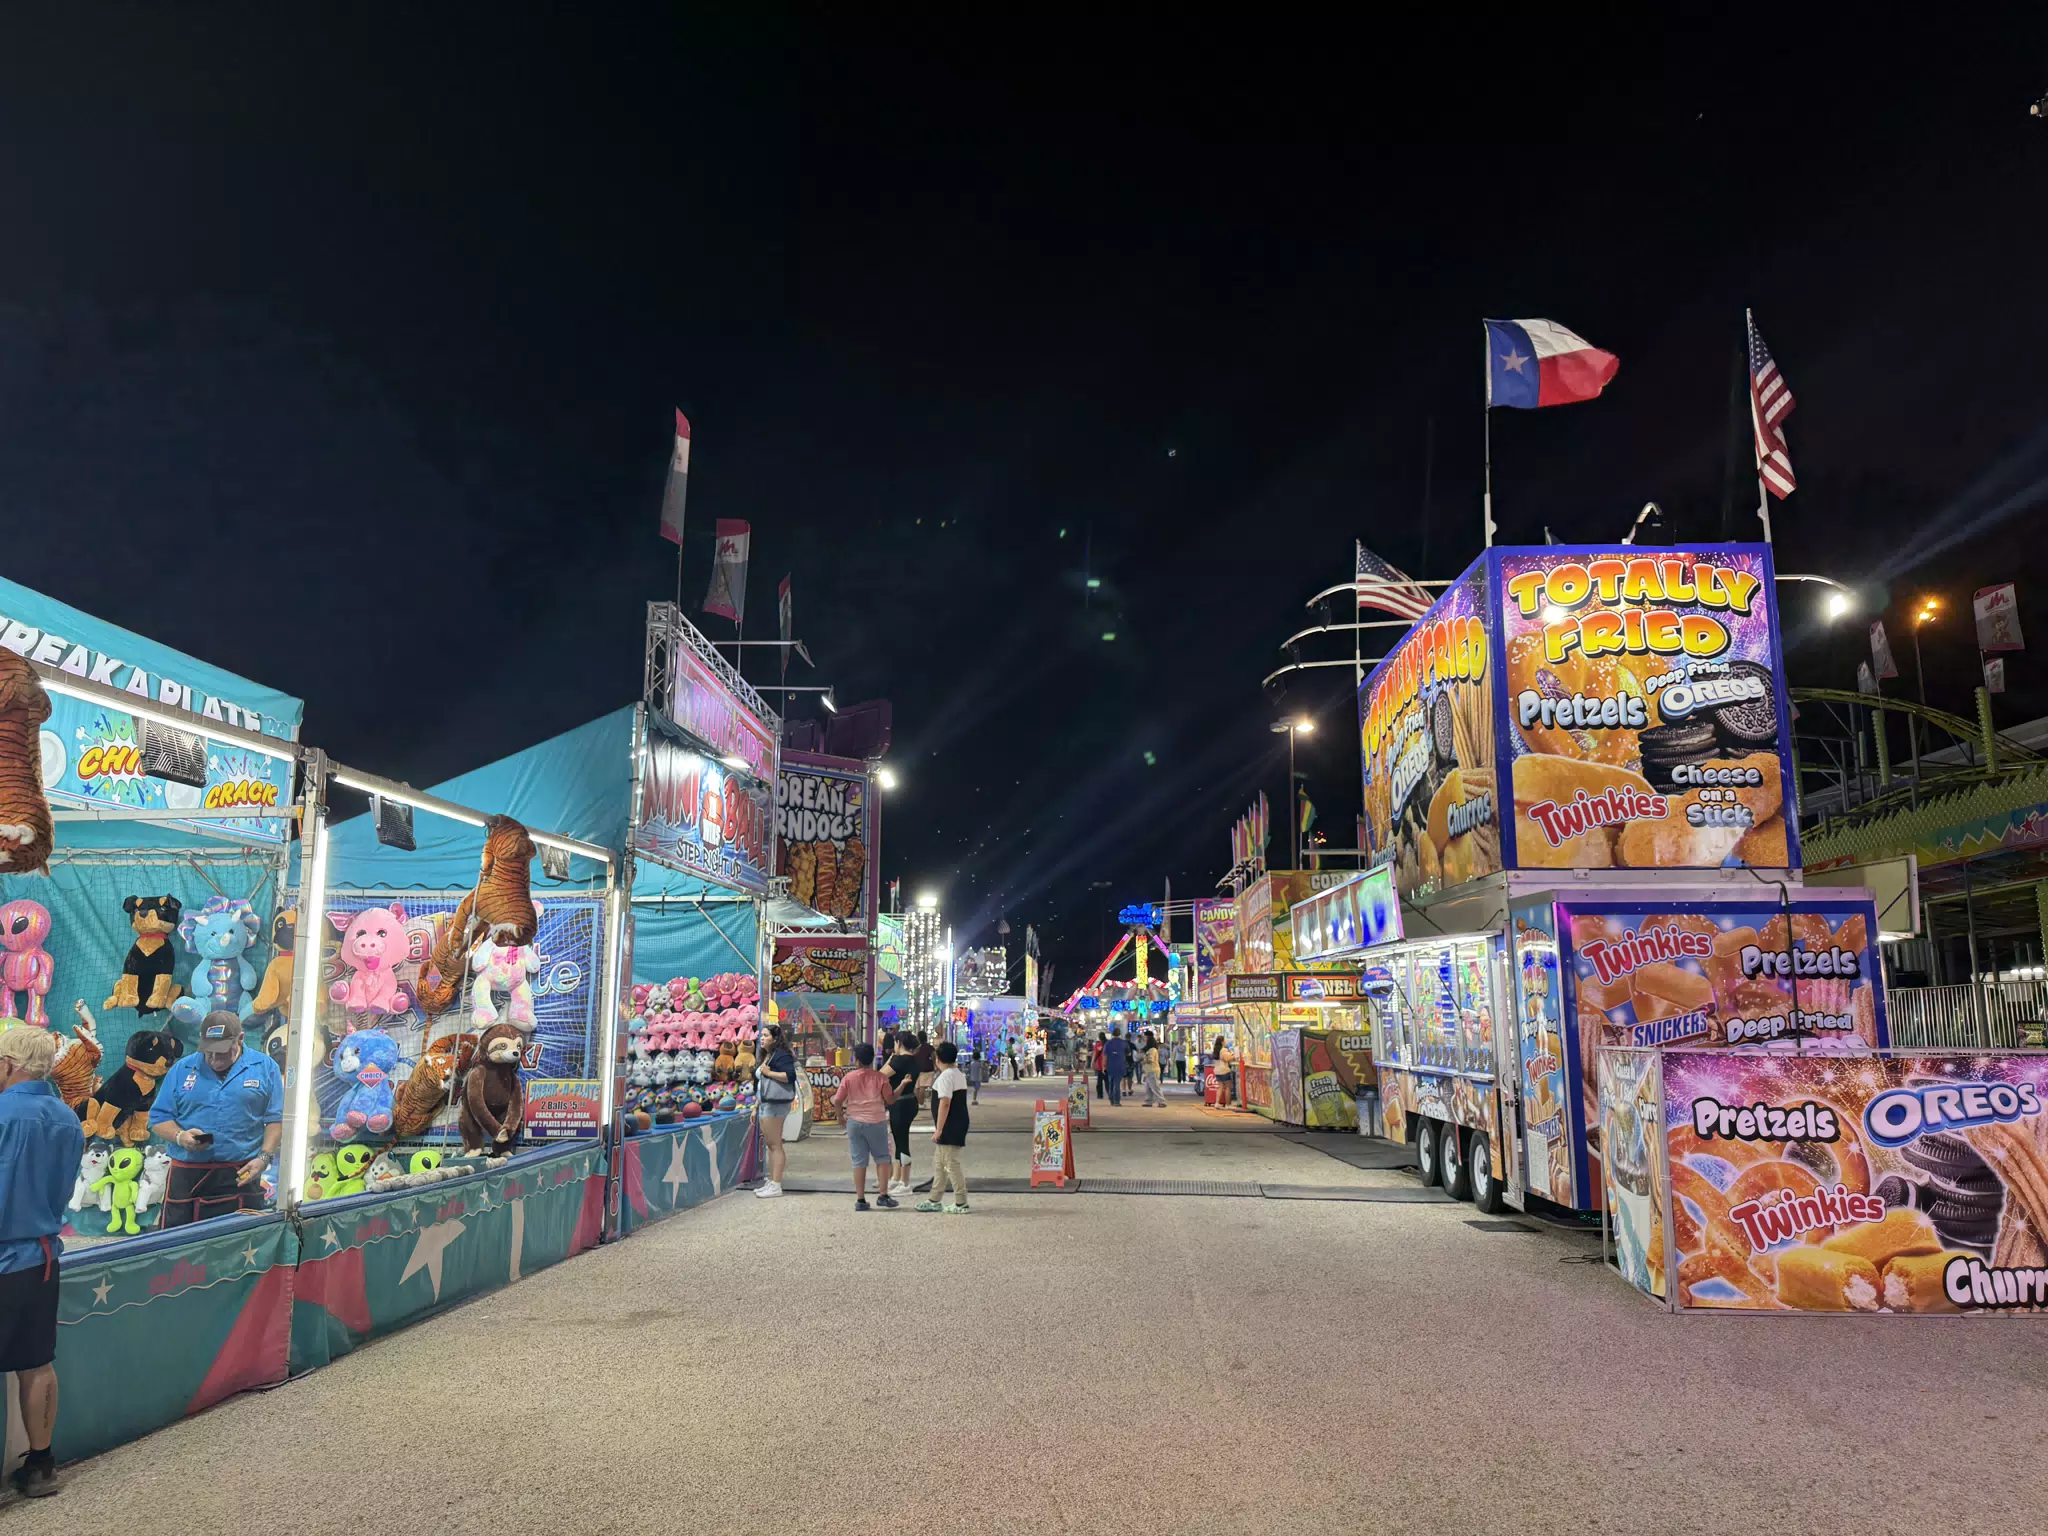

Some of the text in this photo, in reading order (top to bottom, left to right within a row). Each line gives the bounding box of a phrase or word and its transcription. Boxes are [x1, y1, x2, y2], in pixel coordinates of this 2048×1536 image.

[1508, 559, 1759, 614] TOTALLY
[1542, 611, 1728, 661] FRIED
[0, 616, 124, 686] REAK
[126, 666, 149, 698] A
[1362, 616, 1486, 772] TOTALLY FRIED
[1646, 662, 1729, 694] Deep Fried
[1518, 693, 1645, 727] Pretzels
[1661, 677, 1765, 717] OREOS
[78, 745, 146, 780] CHI
[1672, 765, 1760, 785] Cheese
[204, 780, 279, 809] CRACK
[777, 775, 845, 815] OREAN
[1699, 791, 1736, 804] on a
[724, 776, 767, 872] BALL
[776, 807, 854, 841] RNDOGS
[1448, 791, 1491, 836] Churros
[1529, 786, 1668, 846] Twinkies
[1686, 804, 1752, 825] Stick
[676, 837, 742, 879] STEP RIGHT UP
[1200, 908, 1234, 921] CANDY
[811, 949, 848, 959] CLASSIC
[1582, 926, 1712, 984] Twinkies
[1741, 945, 1857, 977] Pretzels
[1230, 986, 1278, 998] LEMONADE
[1293, 979, 1353, 995] FNEL
[1633, 1013, 1707, 1047] SNICKERS
[1726, 1010, 1852, 1043] Deep Fried
[541, 1101, 546, 1110] 2
[548, 1101, 567, 1110] Balls
[1695, 1099, 1838, 1140] Pretzels
[1867, 1084, 2040, 1144] OREOS
[1732, 1186, 1884, 1251] Twinkies
